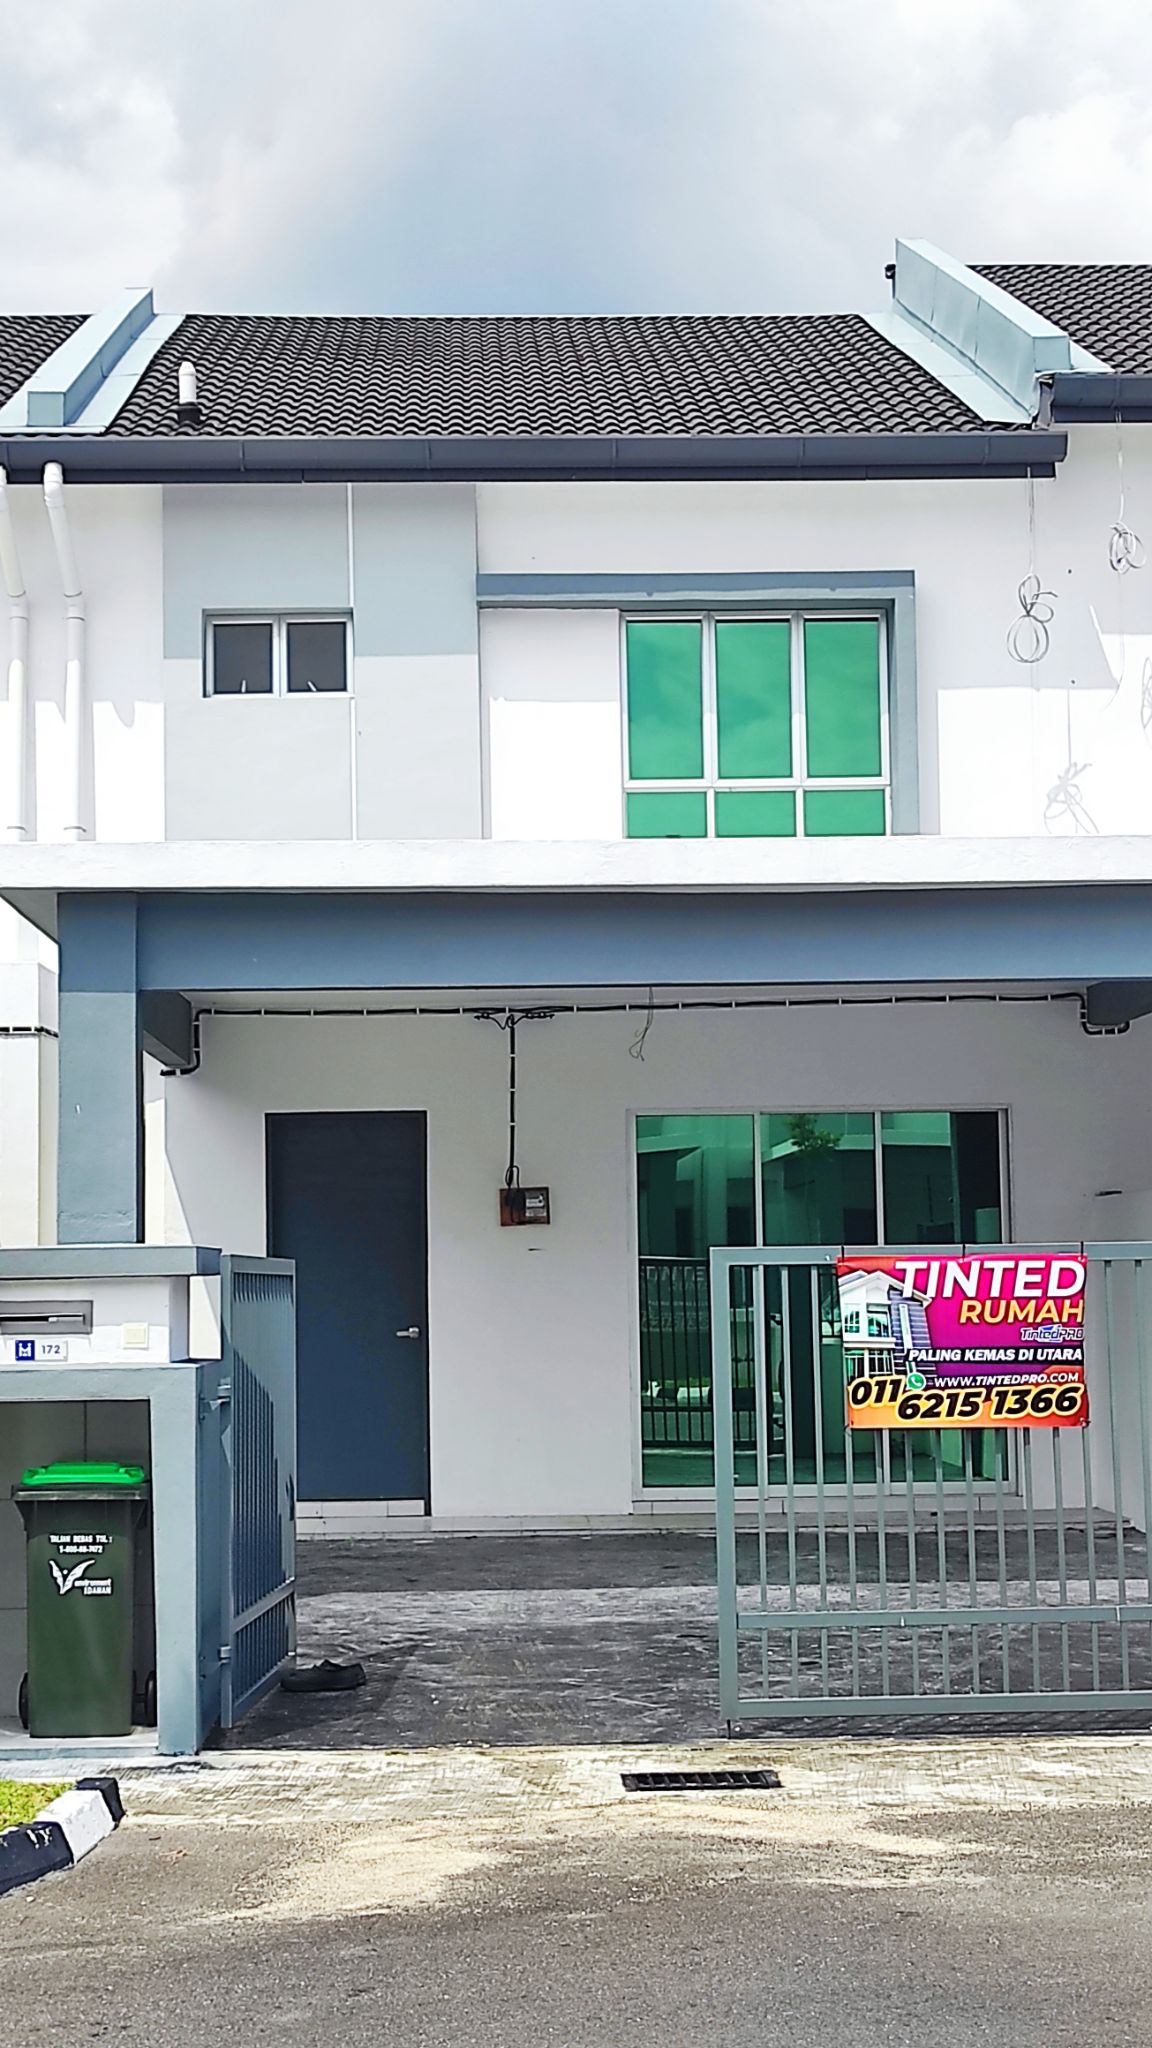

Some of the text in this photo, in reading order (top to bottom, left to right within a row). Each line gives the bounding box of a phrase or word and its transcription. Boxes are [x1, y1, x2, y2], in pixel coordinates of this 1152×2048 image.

[895, 1259, 1085, 1298] TINTED
[959, 1299, 1084, 1324] RUMAH
[41, 1345, 61, 1354] 172
[908, 1348, 1083, 1362] PALING KEMAS DI UTARA
[850, 1377, 903, 1407] 011
[934, 1372, 1079, 1387] WWW.TINTEDPRO.COM
[897, 1385, 1081, 1419] 6215 1366
